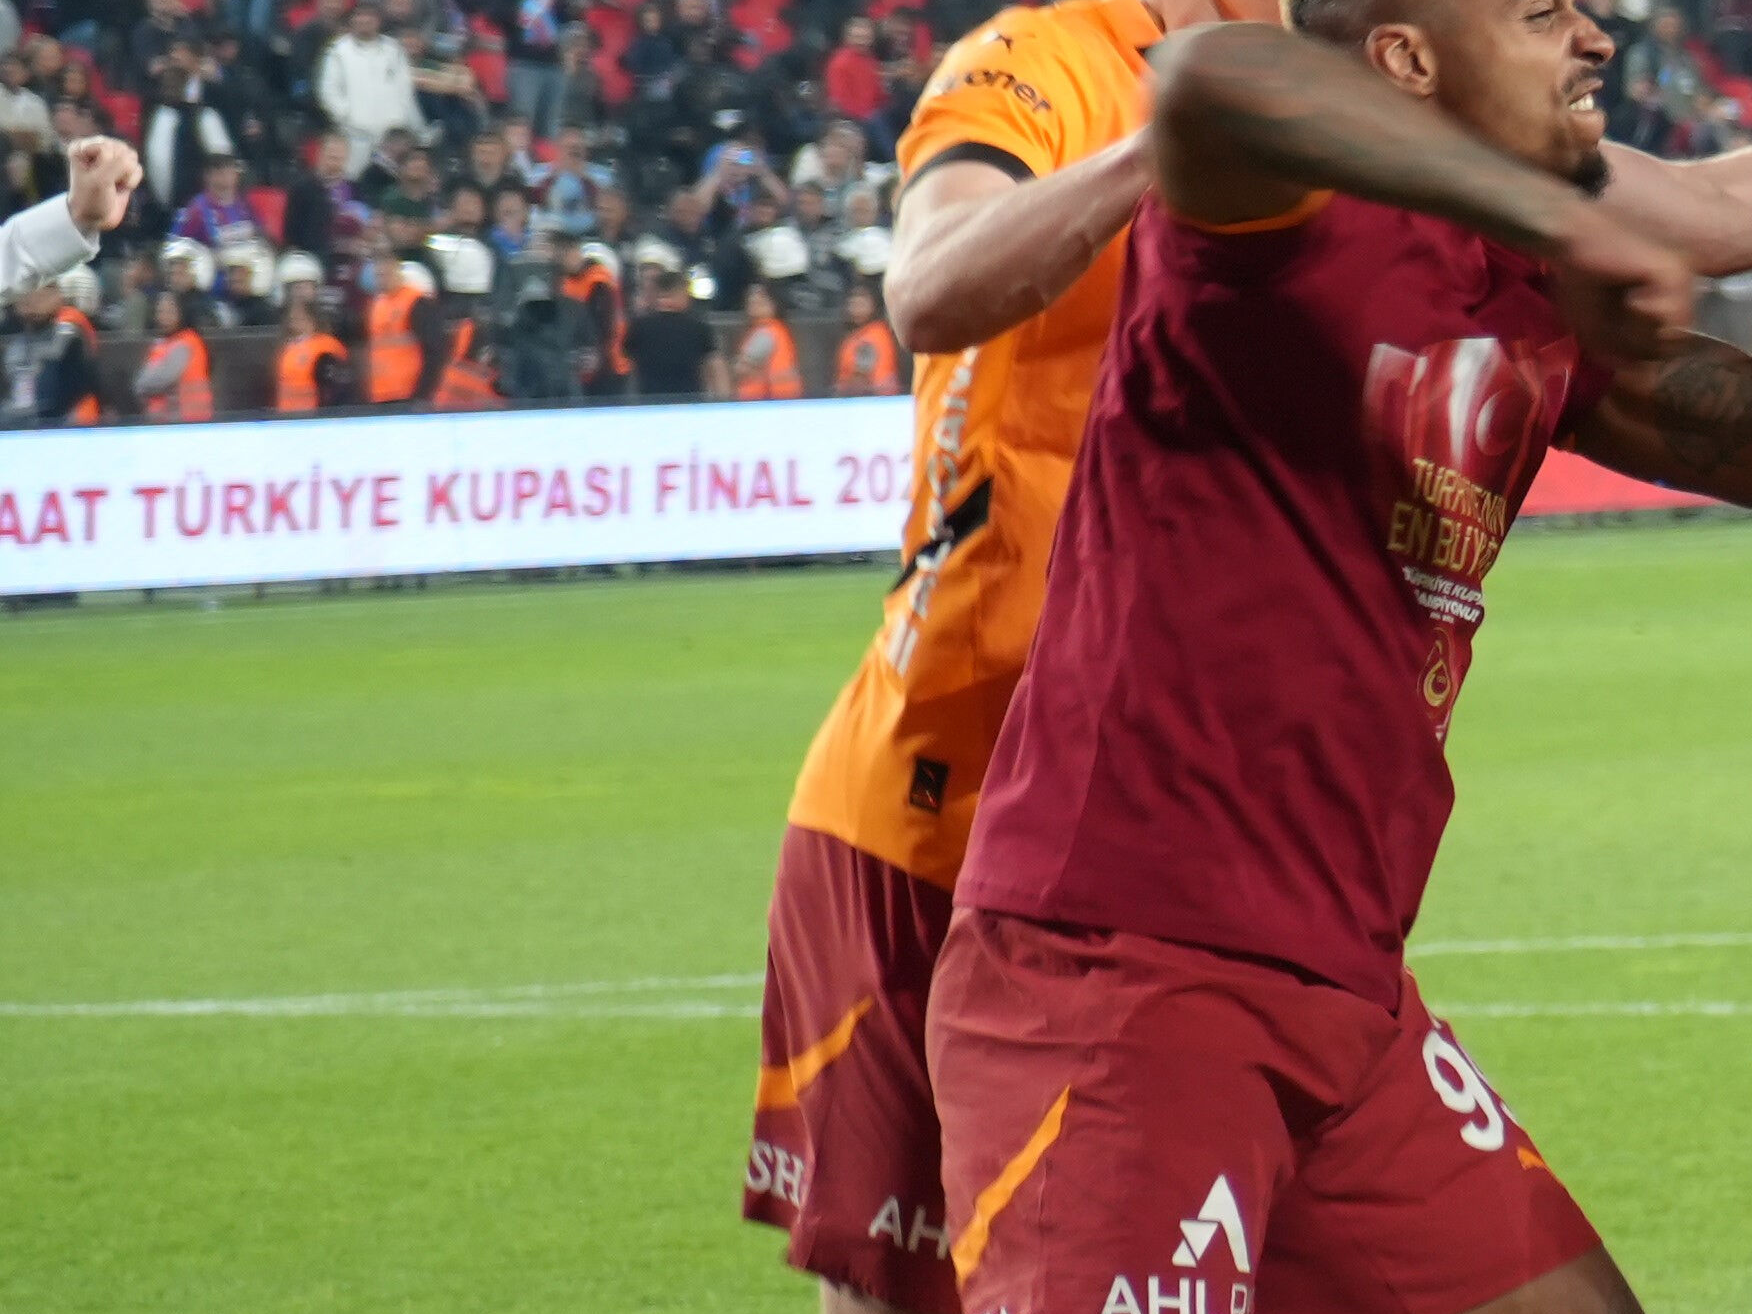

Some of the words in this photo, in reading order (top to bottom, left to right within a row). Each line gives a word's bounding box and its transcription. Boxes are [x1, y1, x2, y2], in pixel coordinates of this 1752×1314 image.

[132, 464, 401, 542] TÜRKİYE
[426, 466, 631, 526] KUPASI
[655, 449, 813, 515] FİNAL
[1422, 1030, 1506, 1152] 9
